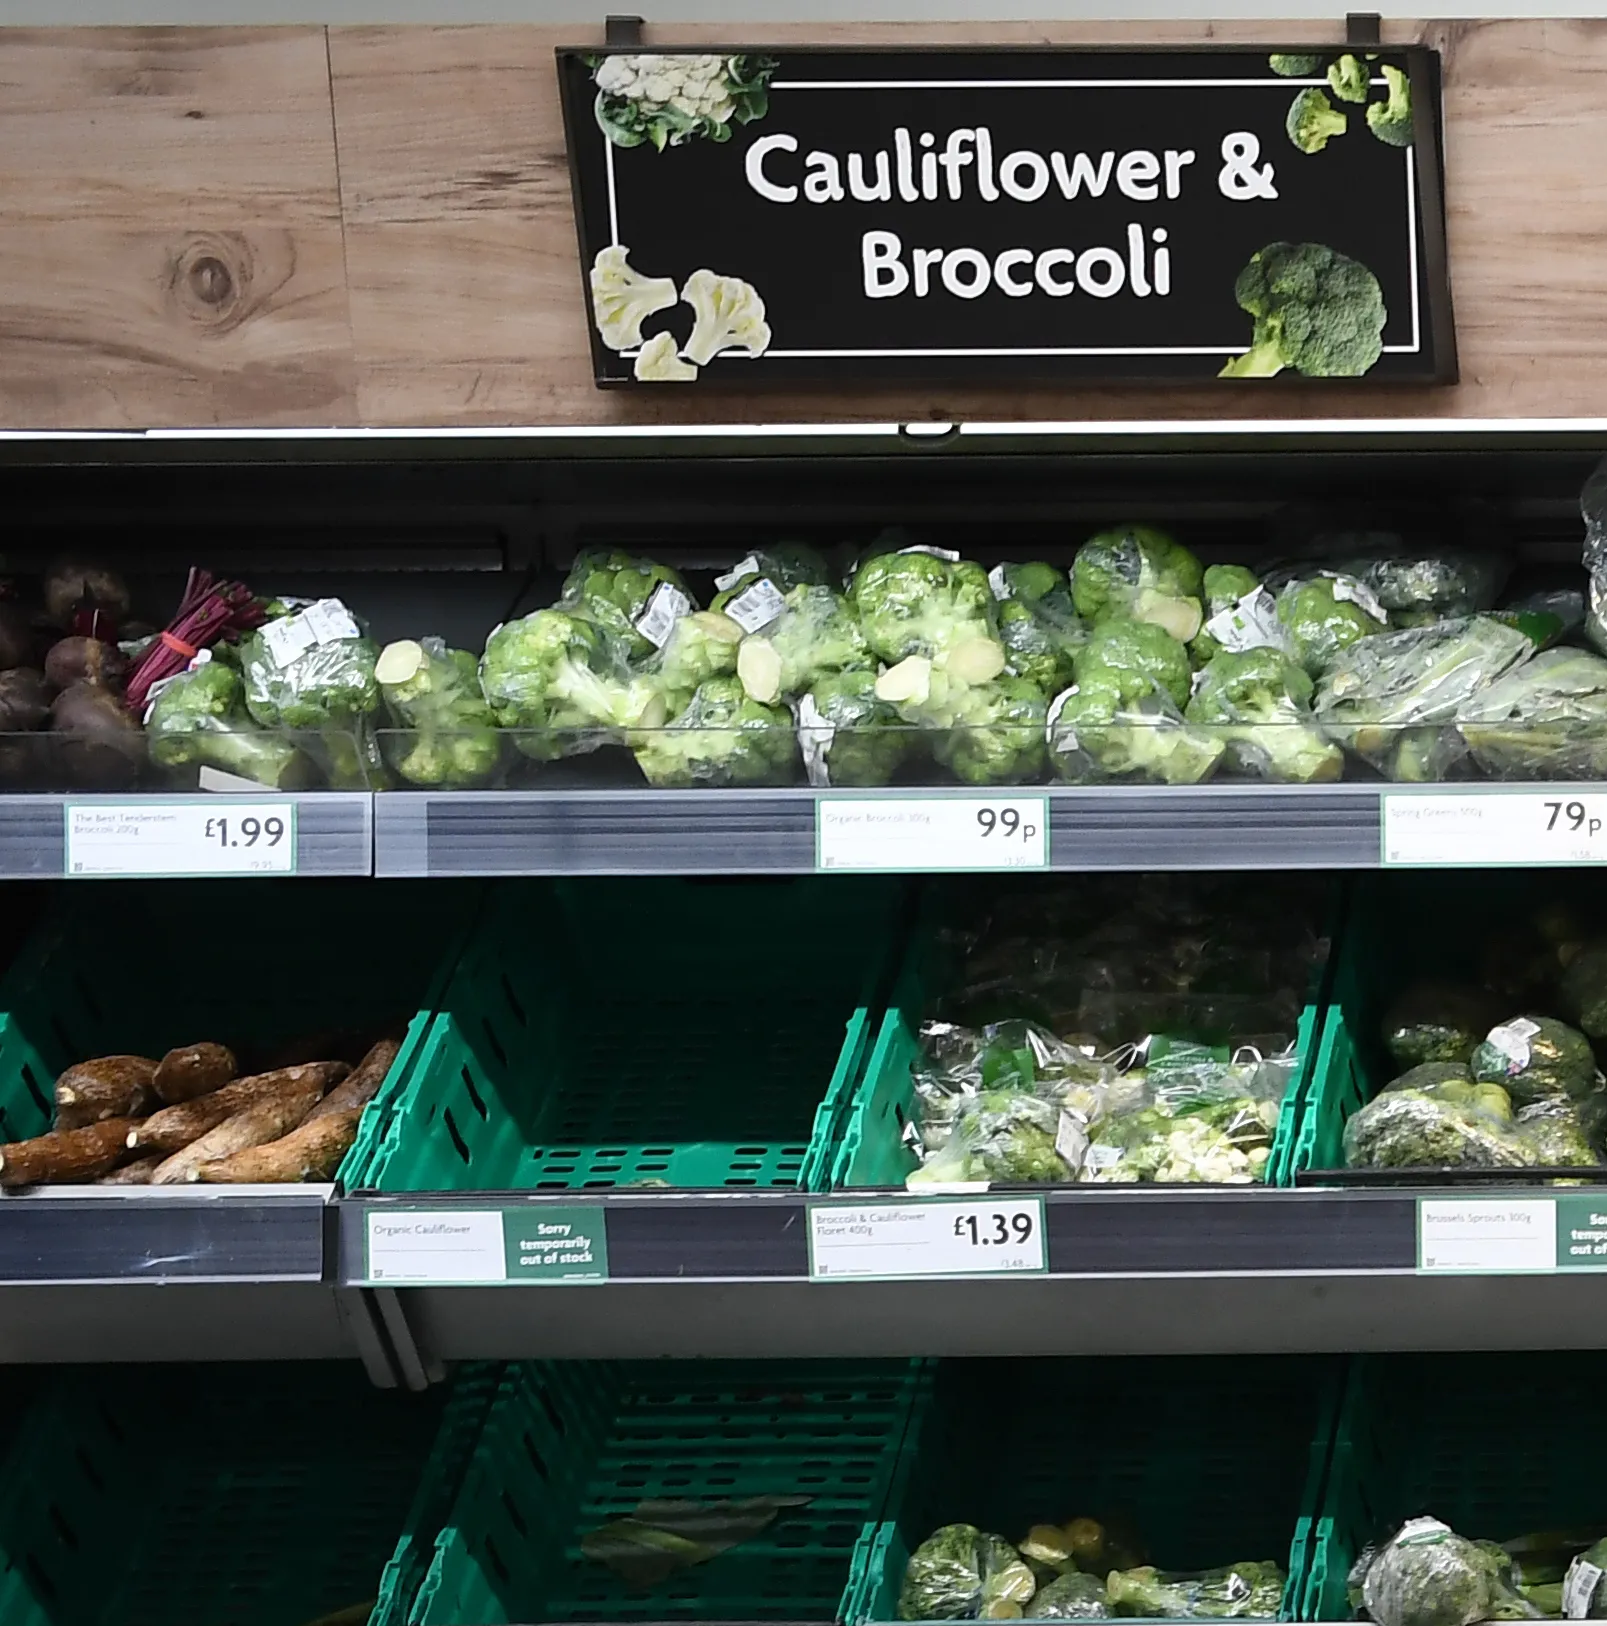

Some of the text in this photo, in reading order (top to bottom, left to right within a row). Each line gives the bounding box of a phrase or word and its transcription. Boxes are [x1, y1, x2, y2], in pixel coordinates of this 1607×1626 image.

[746, 128, 1278, 202] Cauliflower &
[863, 224, 1169, 298] Broccoli
[977, 808, 1035, 842] 99p
[1544, 802, 1601, 836] 79p
[205, 817, 284, 847] £1.99
[816, 1214, 857, 1225] Broccoli
[869, 1211, 926, 1223] Cauliflower
[1426, 1212, 1506, 1226] Brussels Sprouts
[374, 1223, 471, 1237] Organic Cauliflower
[537, 1222, 572, 1238] Sorry
[954, 1213, 1032, 1245] £1.39
[519, 1236, 590, 1252] temporarily
[1570, 1244, 1591, 1255] out
[1594, 1241, 1607, 1254] of
[520, 1250, 593, 1265] out of stock
